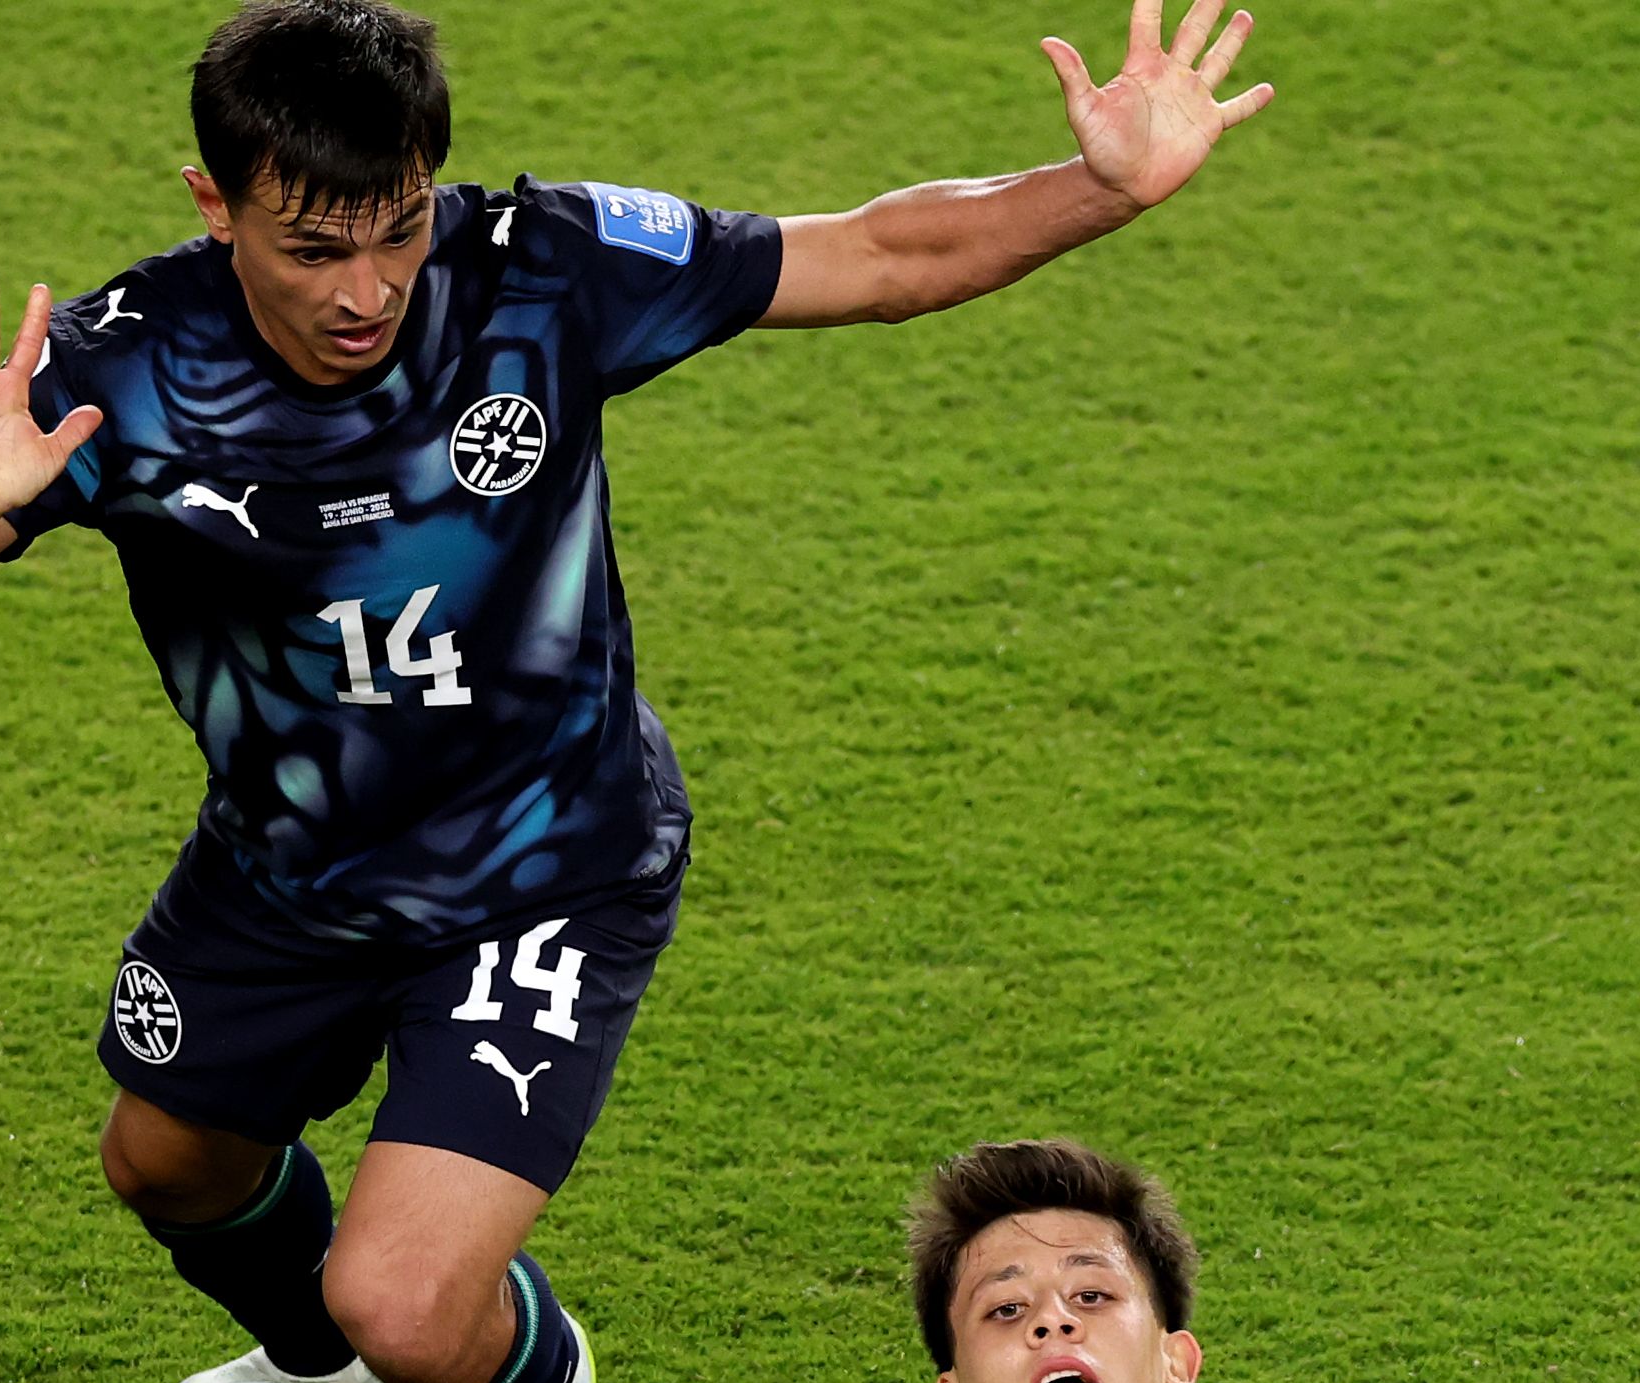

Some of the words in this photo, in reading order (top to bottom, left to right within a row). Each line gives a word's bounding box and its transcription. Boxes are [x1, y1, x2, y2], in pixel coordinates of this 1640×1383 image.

[473, 400, 503, 430] APF
[489, 461, 532, 490] PARAGUAY
[323, 511, 333, 520] 19
[340, 507, 364, 517] JUNIO
[370, 501, 390, 512] 2026
[347, 499, 357, 507] VS
[357, 492, 389, 505] PARAGUAY
[362, 509, 394, 521] FRANCISCO
[316, 584, 472, 707] 14
[140, 972, 165, 1001] APF
[450, 917, 588, 1043] 14
[120, 1024, 152, 1058] PARAGUAY
